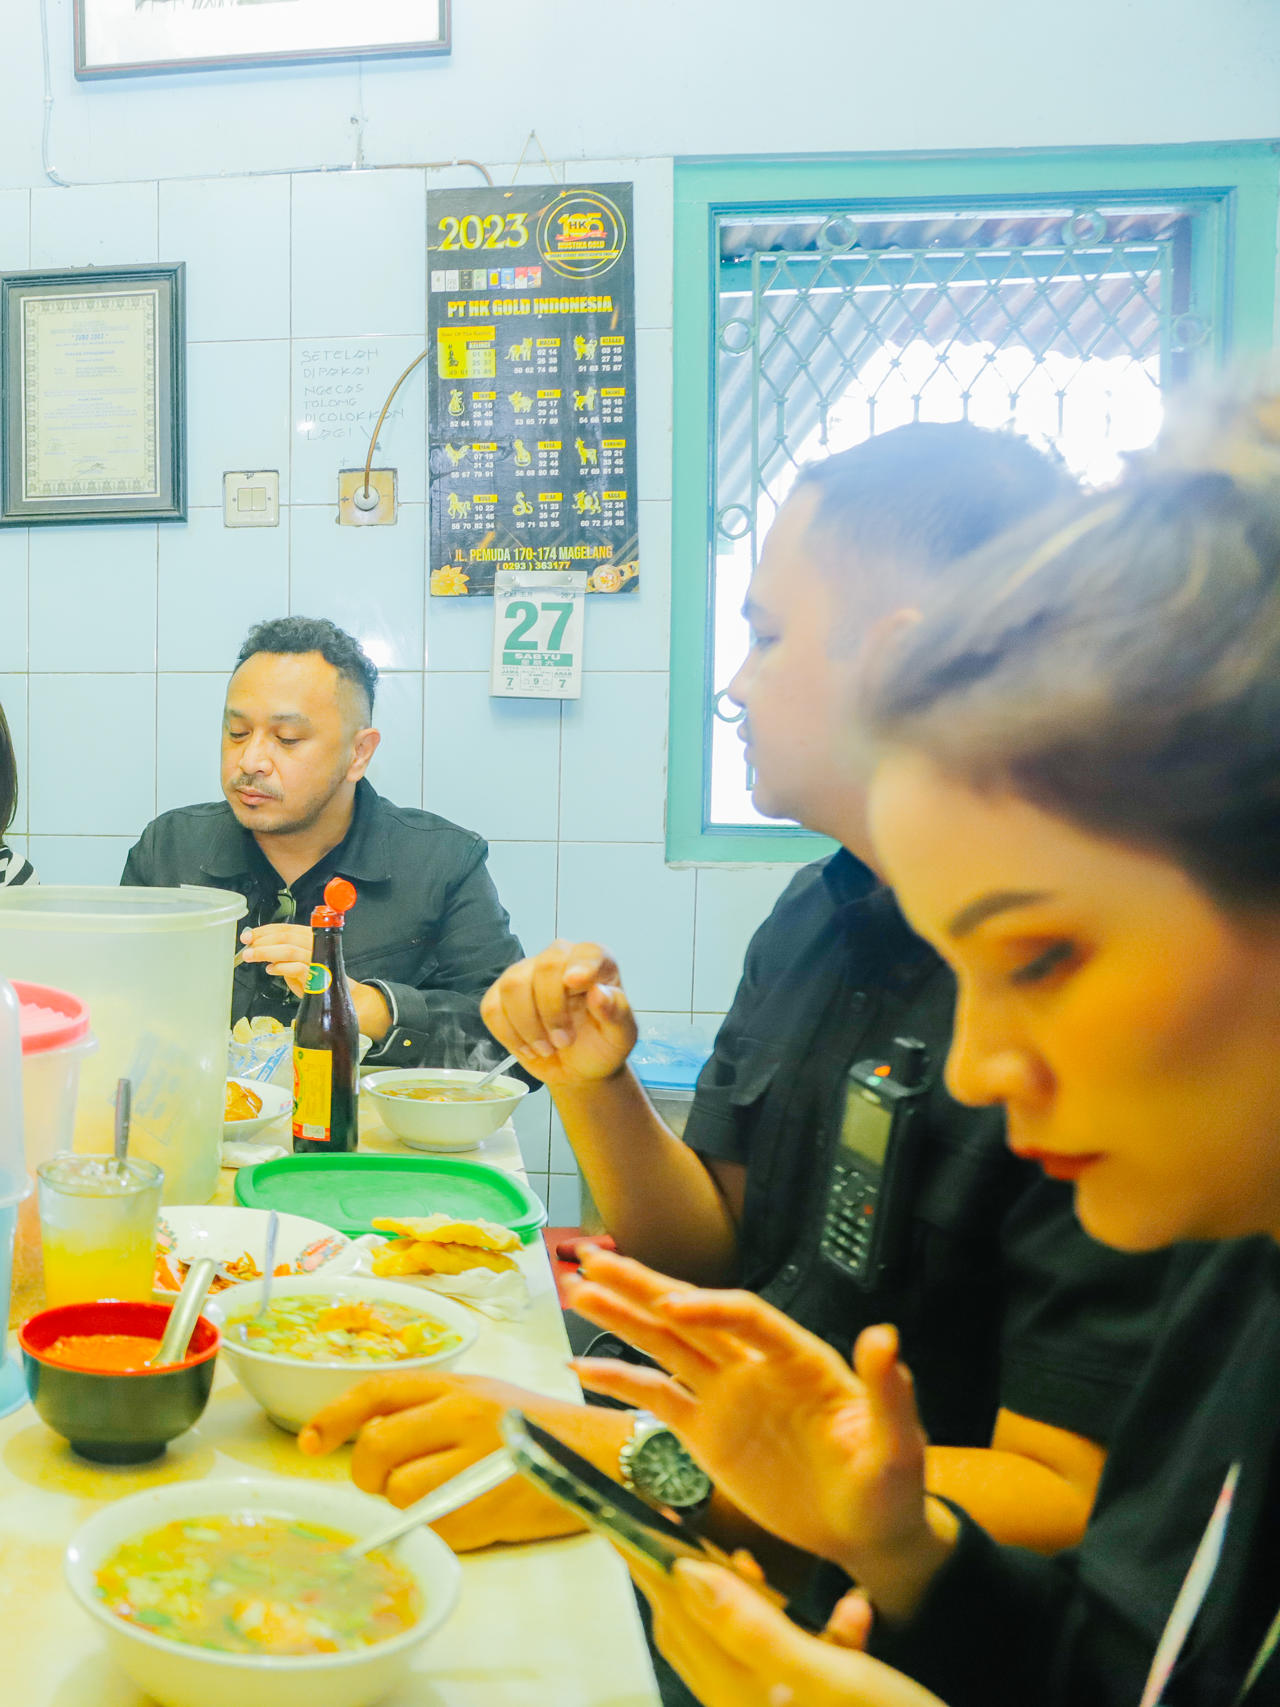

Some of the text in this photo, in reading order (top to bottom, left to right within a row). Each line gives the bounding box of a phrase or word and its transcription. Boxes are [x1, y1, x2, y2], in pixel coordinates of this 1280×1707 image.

[437, 213, 529, 251] 2023
[448, 296, 613, 318] PT HK GOLD INDONESIA
[454, 546, 613, 562] JL. PEMUDA 170-174 MAGELANG
[535, 561, 571, 570] 363177
[504, 601, 574, 650] 27
[507, 678, 566, 688] 7 7
